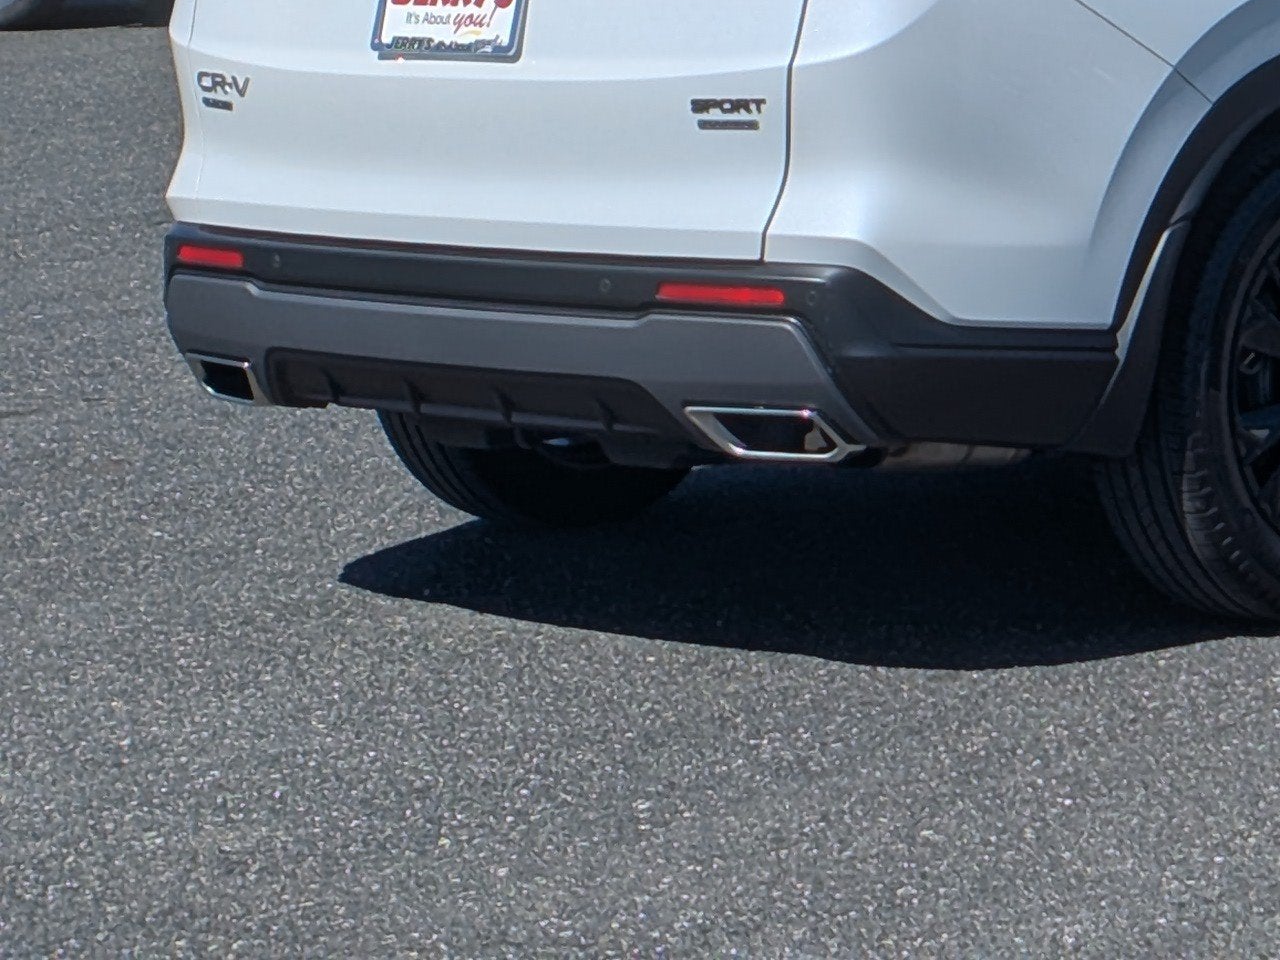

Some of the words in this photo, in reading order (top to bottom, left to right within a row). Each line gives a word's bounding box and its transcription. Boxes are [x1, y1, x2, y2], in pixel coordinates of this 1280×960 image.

[405, 11, 420, 24] It's
[422, 12, 451, 25] About
[453, 4, 498, 34] you!
[197, 71, 251, 98] CR-V
[690, 98, 767, 115] SPORT
